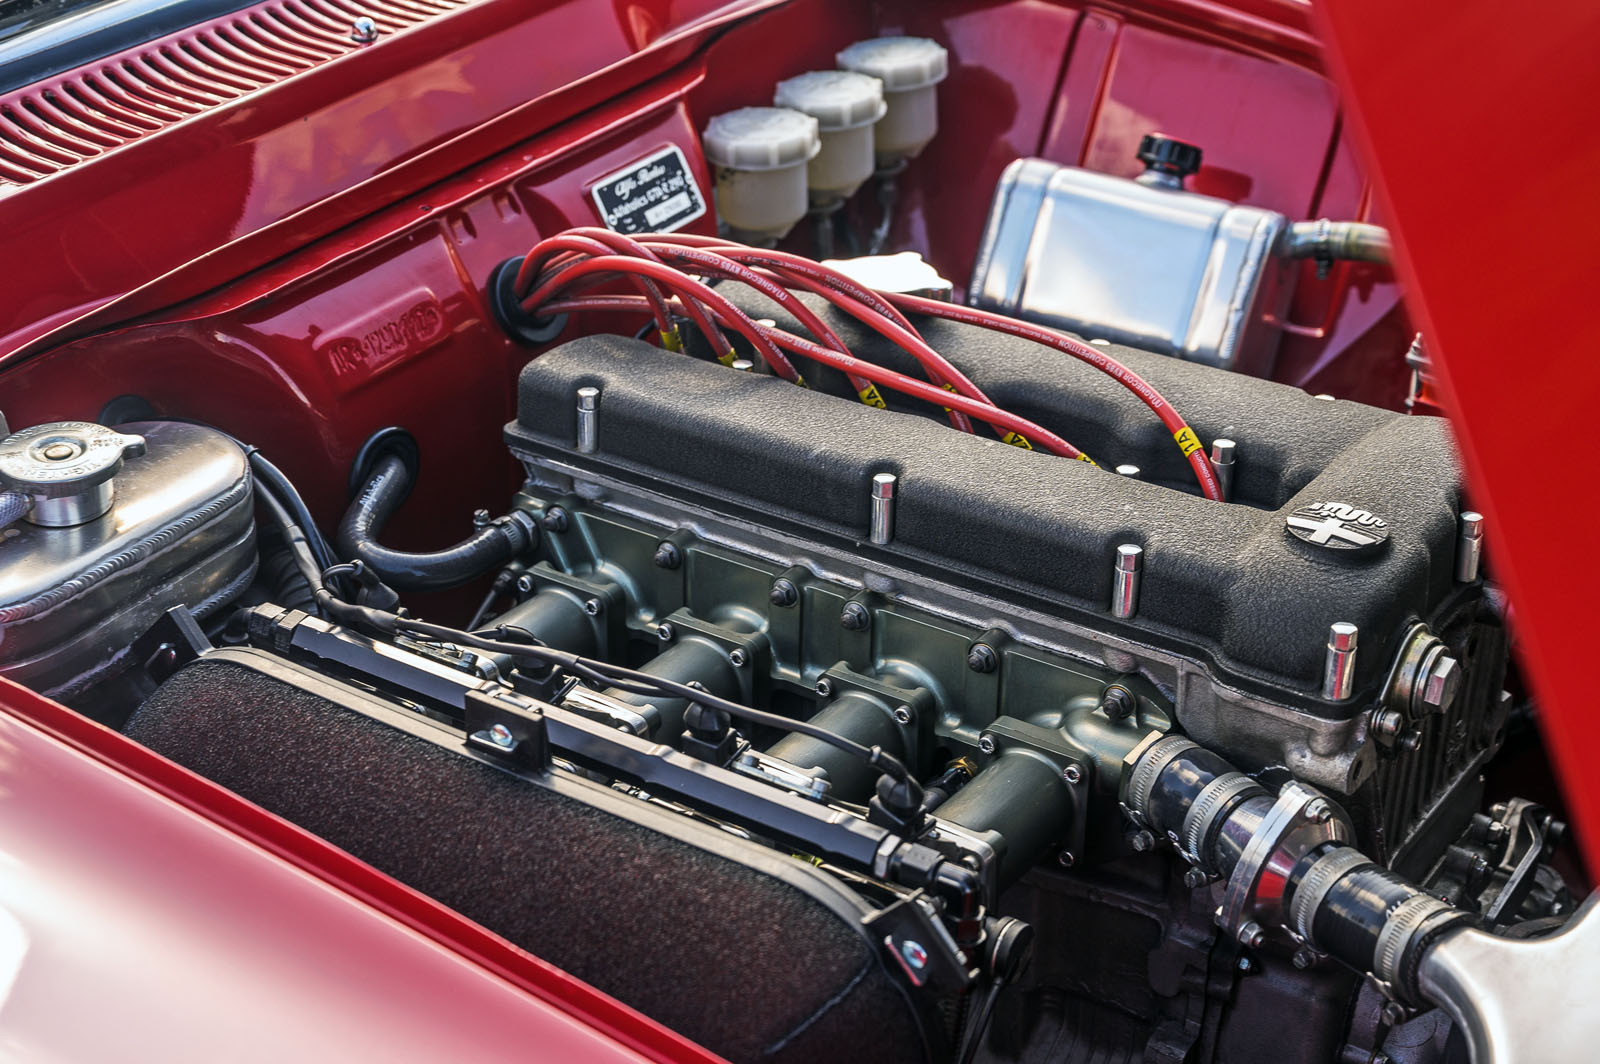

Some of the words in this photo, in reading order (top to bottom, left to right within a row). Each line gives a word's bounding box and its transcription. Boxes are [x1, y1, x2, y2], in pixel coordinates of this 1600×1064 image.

[667, 246, 720, 264] COMPETITION
[720, 260, 741, 274] KV85
[740, 268, 787, 301] MAGNECOR
[824, 273, 876, 306] COMPETITION
[1057, 338, 1106, 366] COMPETITION
[1104, 361, 1124, 377] KV85
[1122, 372, 1162, 408] MAGNECOR
[1178, 431, 1193, 452] 1A
[1193, 449, 1210, 478] CONDUCTO
